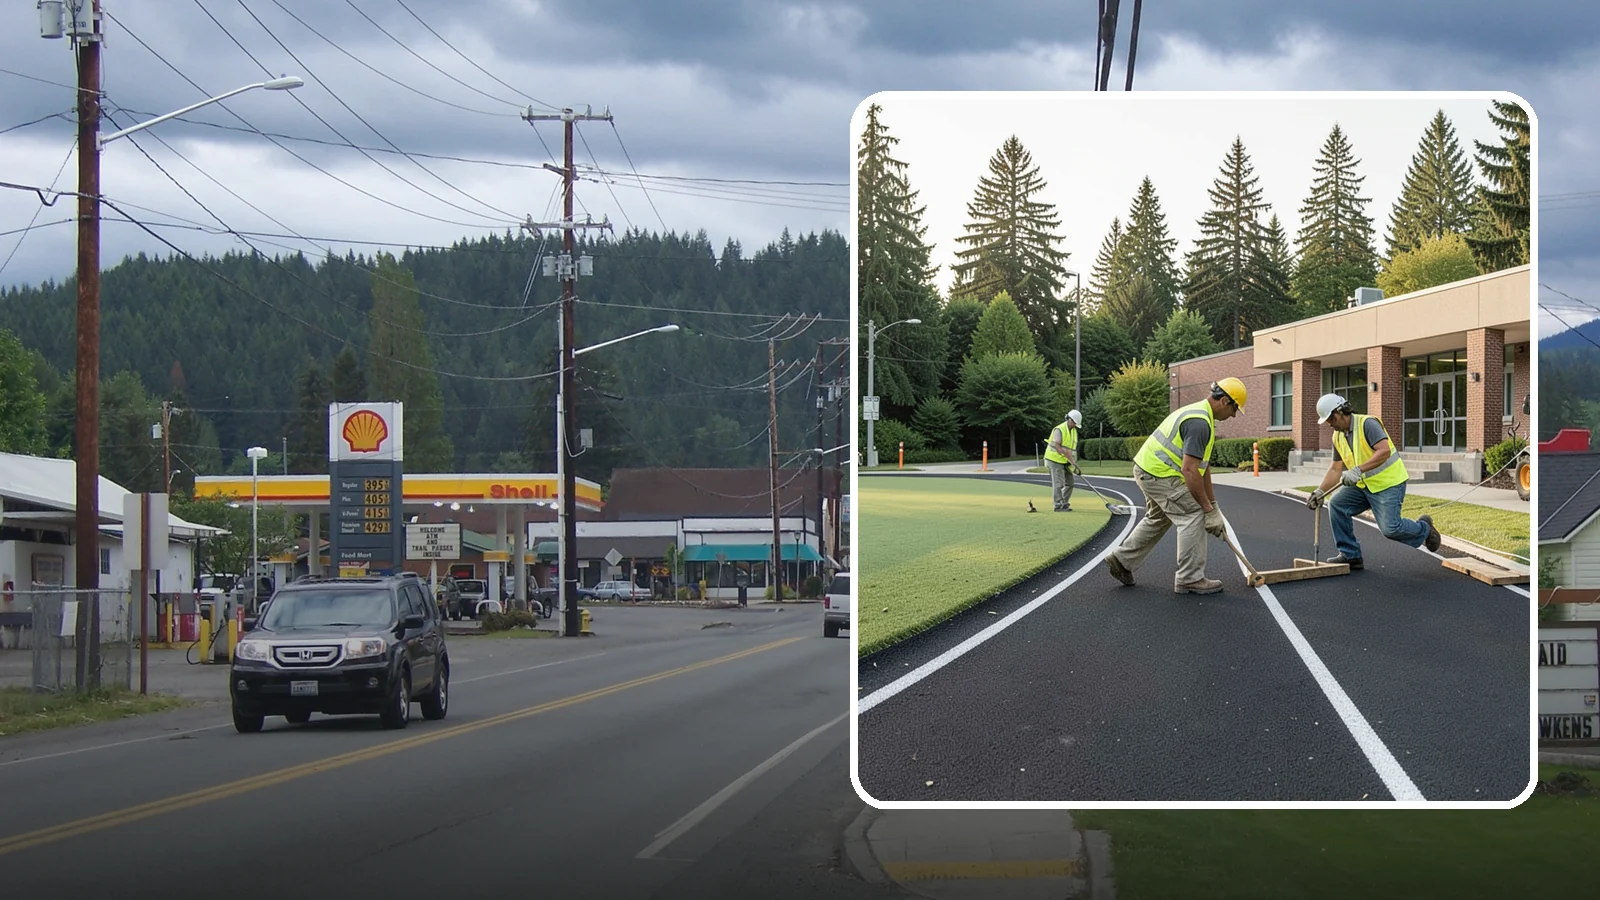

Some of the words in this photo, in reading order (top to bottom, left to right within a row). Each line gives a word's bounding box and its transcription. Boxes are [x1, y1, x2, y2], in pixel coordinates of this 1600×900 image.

[365, 480, 384, 490] 395
[489, 484, 547, 499] Shell
[365, 494, 384, 504] 405
[365, 508, 384, 518] 415
[365, 522, 384, 533] 429
